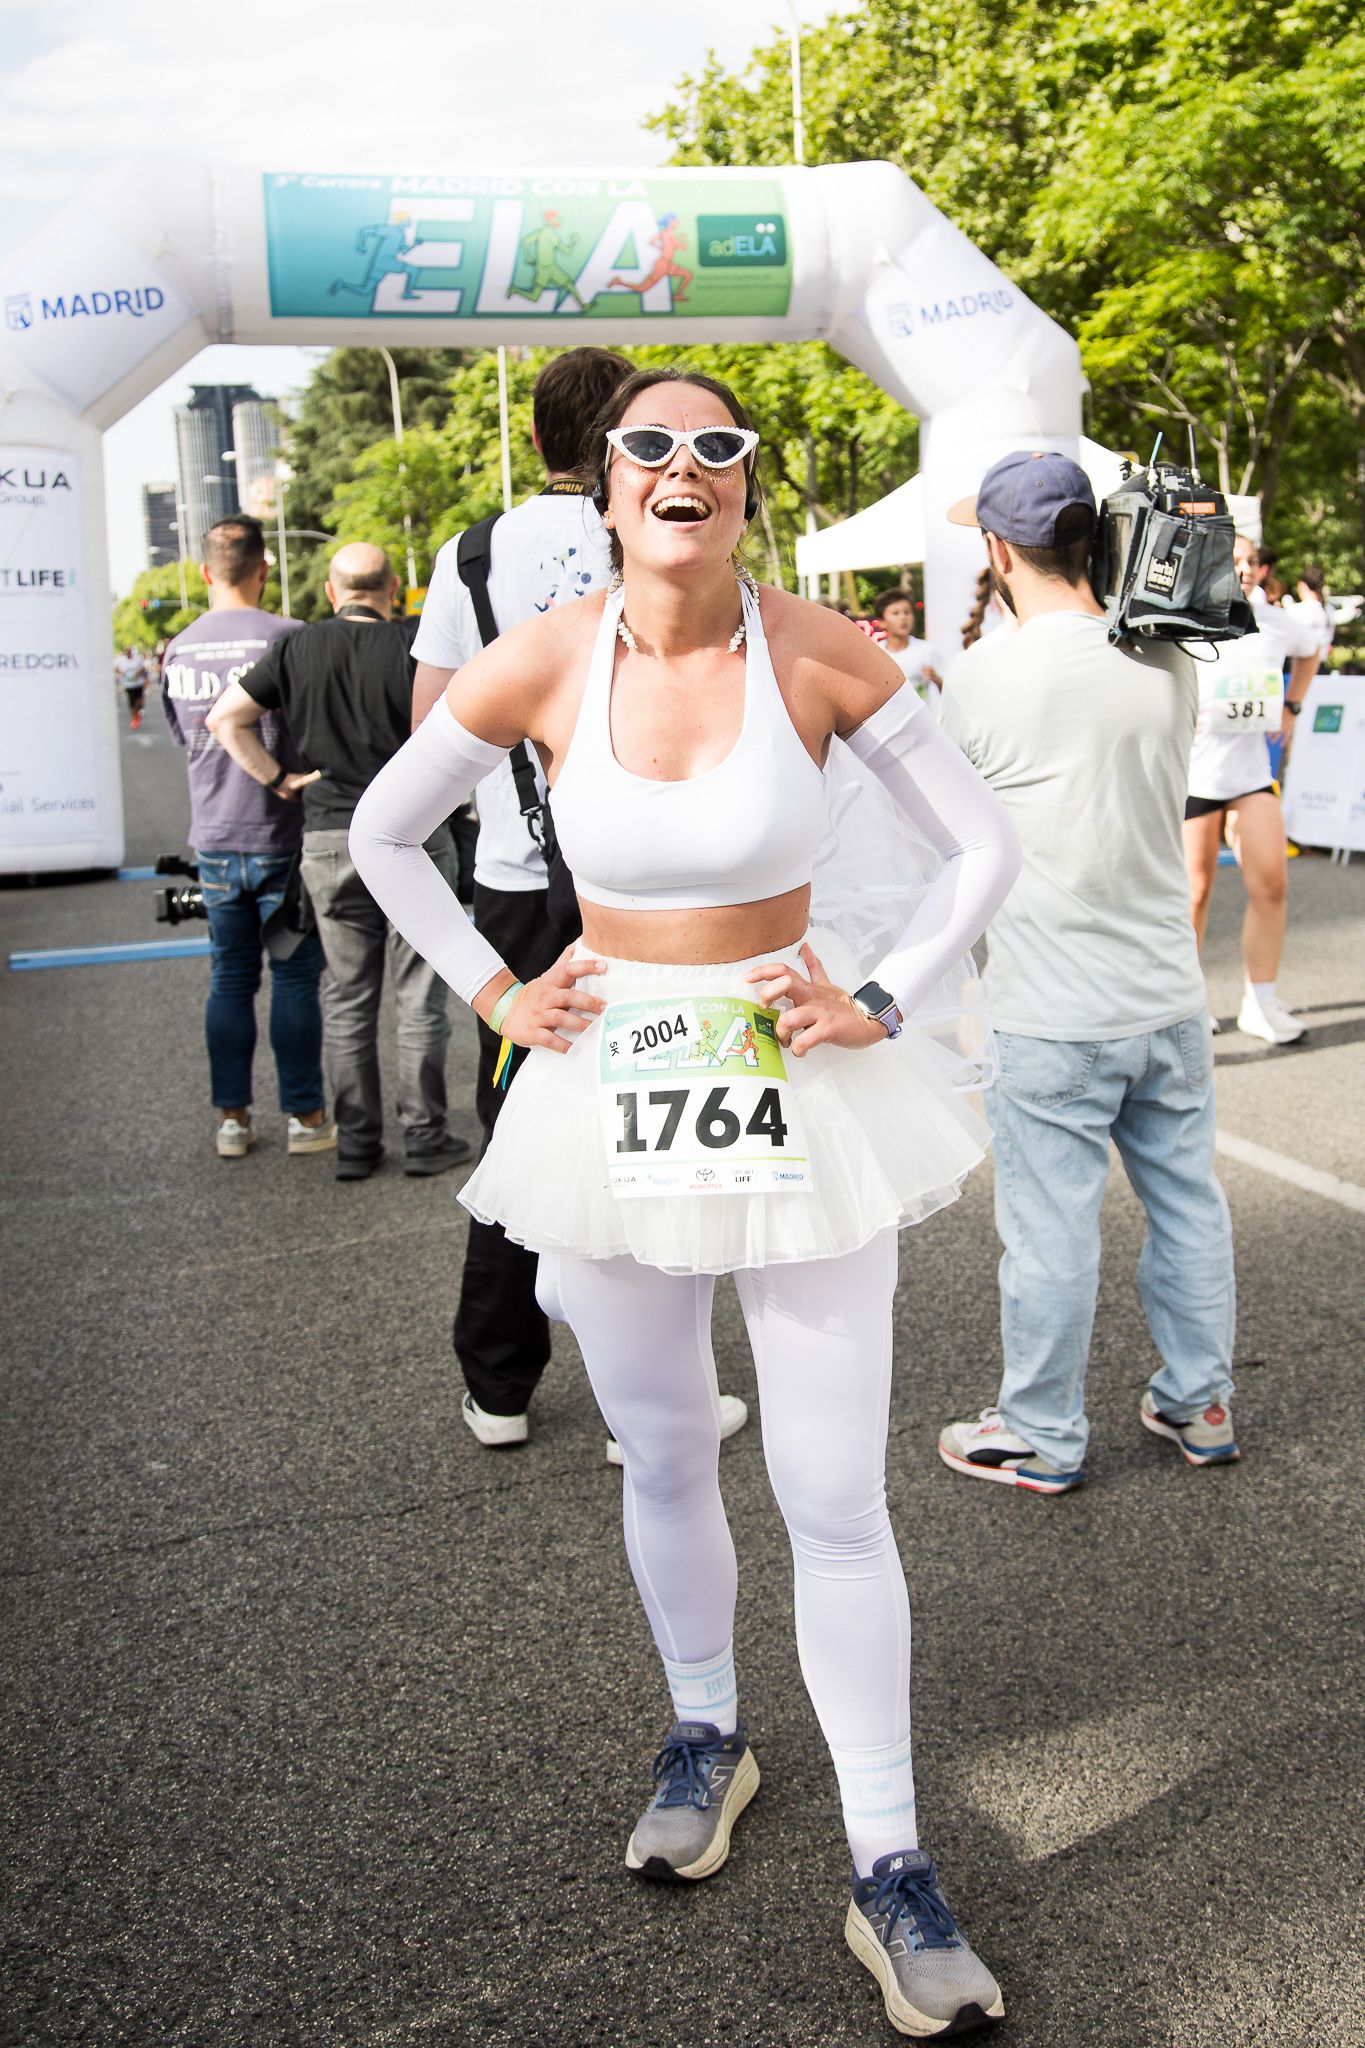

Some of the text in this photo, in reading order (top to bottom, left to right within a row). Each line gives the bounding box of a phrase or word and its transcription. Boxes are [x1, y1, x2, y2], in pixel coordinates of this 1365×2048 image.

[391, 176, 524, 194] MADRID
[531, 178, 600, 195] CON
[608, 180, 648, 196] LA
[371, 197, 674, 314] ELA
[41, 287, 164, 320] MADRID
[920, 289, 1014, 324] MADRID
[553, 483, 584, 493] Nikon
[17, 569, 66, 588] LIFE
[1227, 701, 1265, 719] 381
[700, 1002, 729, 1014] CON
[731, 1003, 745, 1014] LA
[630, 1014, 688, 1054] 2004
[609, 1041, 620, 1057] 5K
[616, 1086, 788, 1153] 1764
